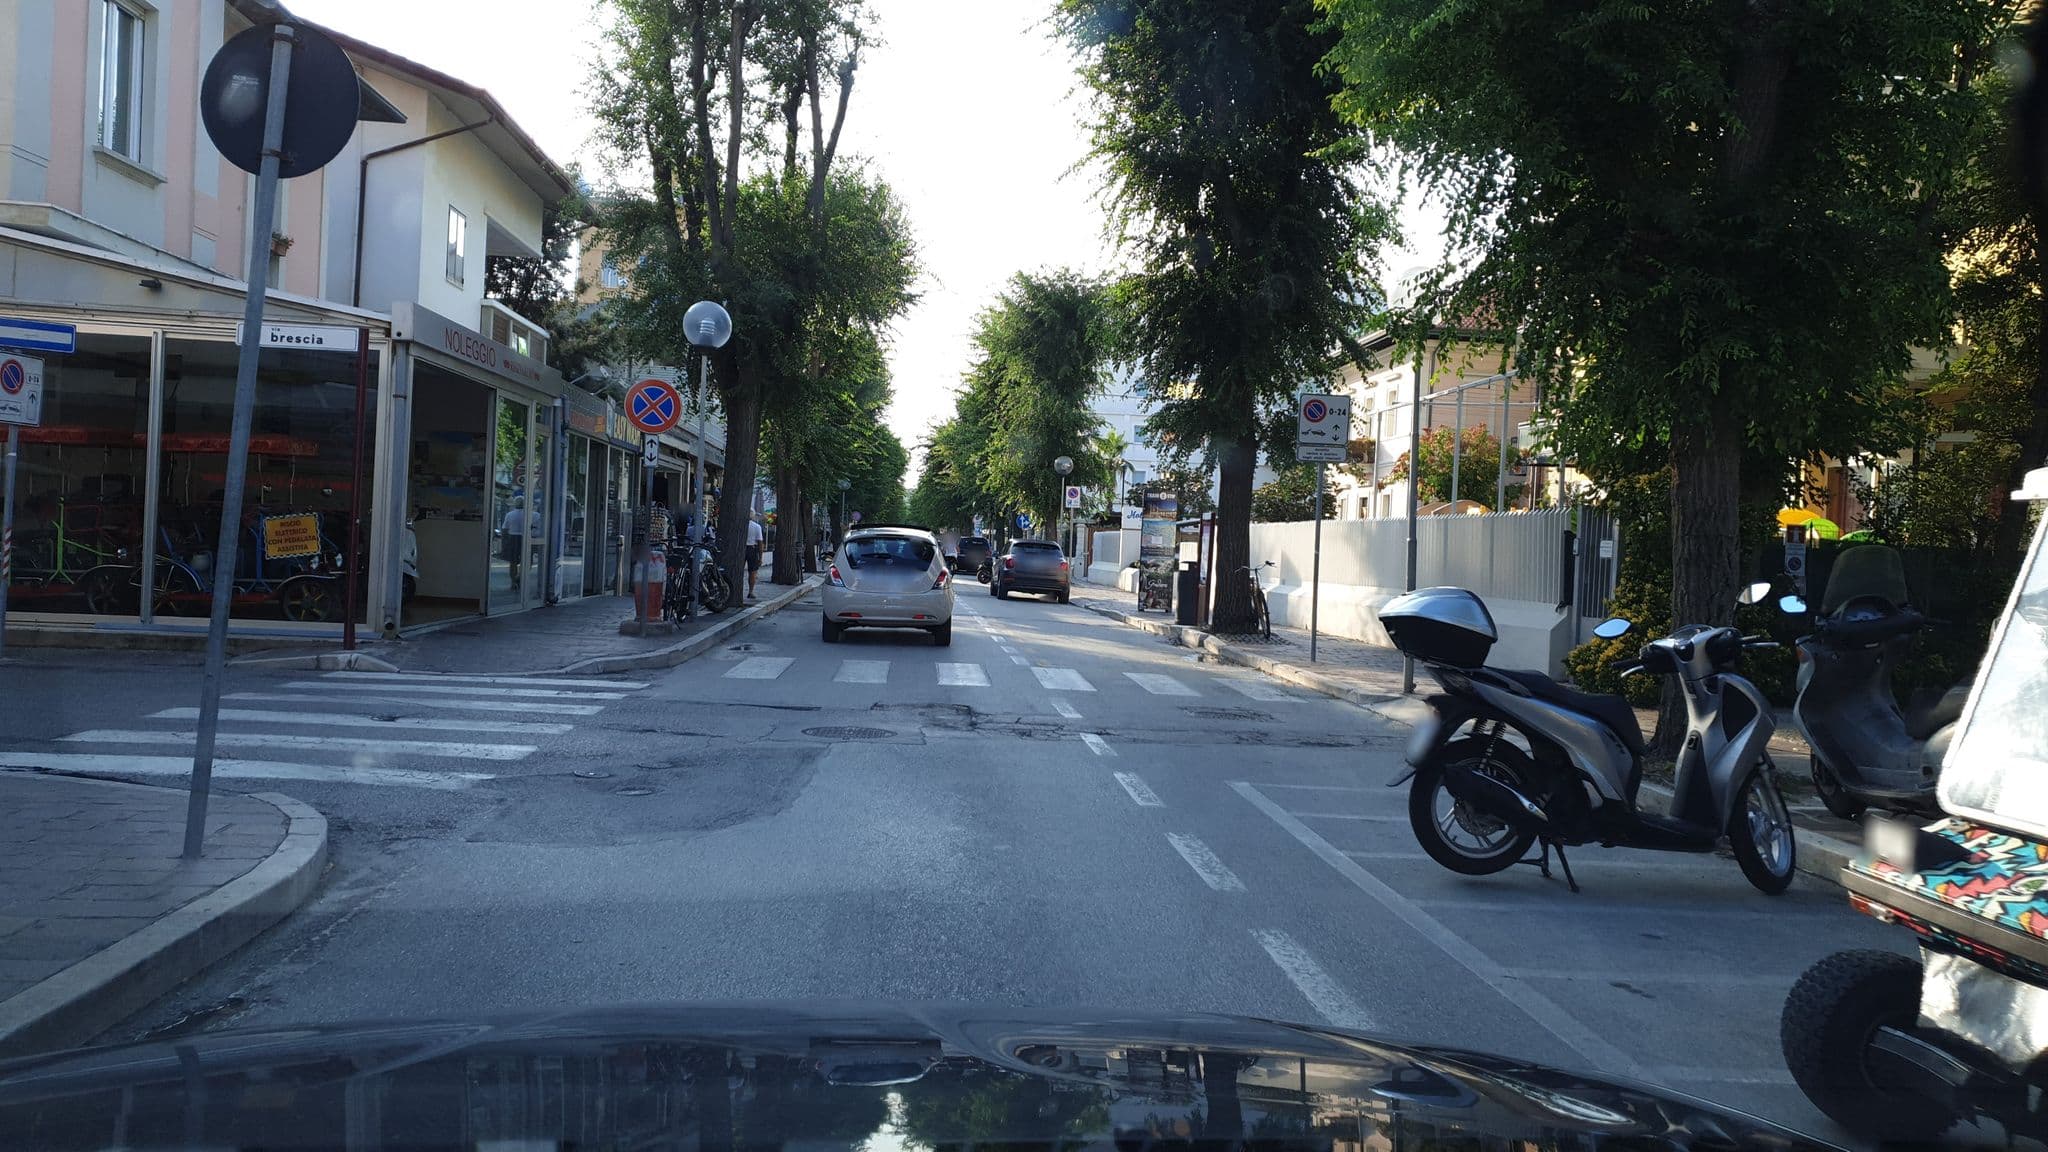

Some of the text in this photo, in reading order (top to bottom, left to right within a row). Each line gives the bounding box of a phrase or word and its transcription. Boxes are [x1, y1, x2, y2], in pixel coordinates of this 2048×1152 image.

[271, 332, 324, 345] brescia
[445, 327, 497, 368] NOLEGGIO
[1329, 408, 1346, 416] 0-24
[1127, 510, 1143, 519] Hot
[275, 528, 308, 536] ELETTRICO
[284, 535, 317, 544] PEDALATA
